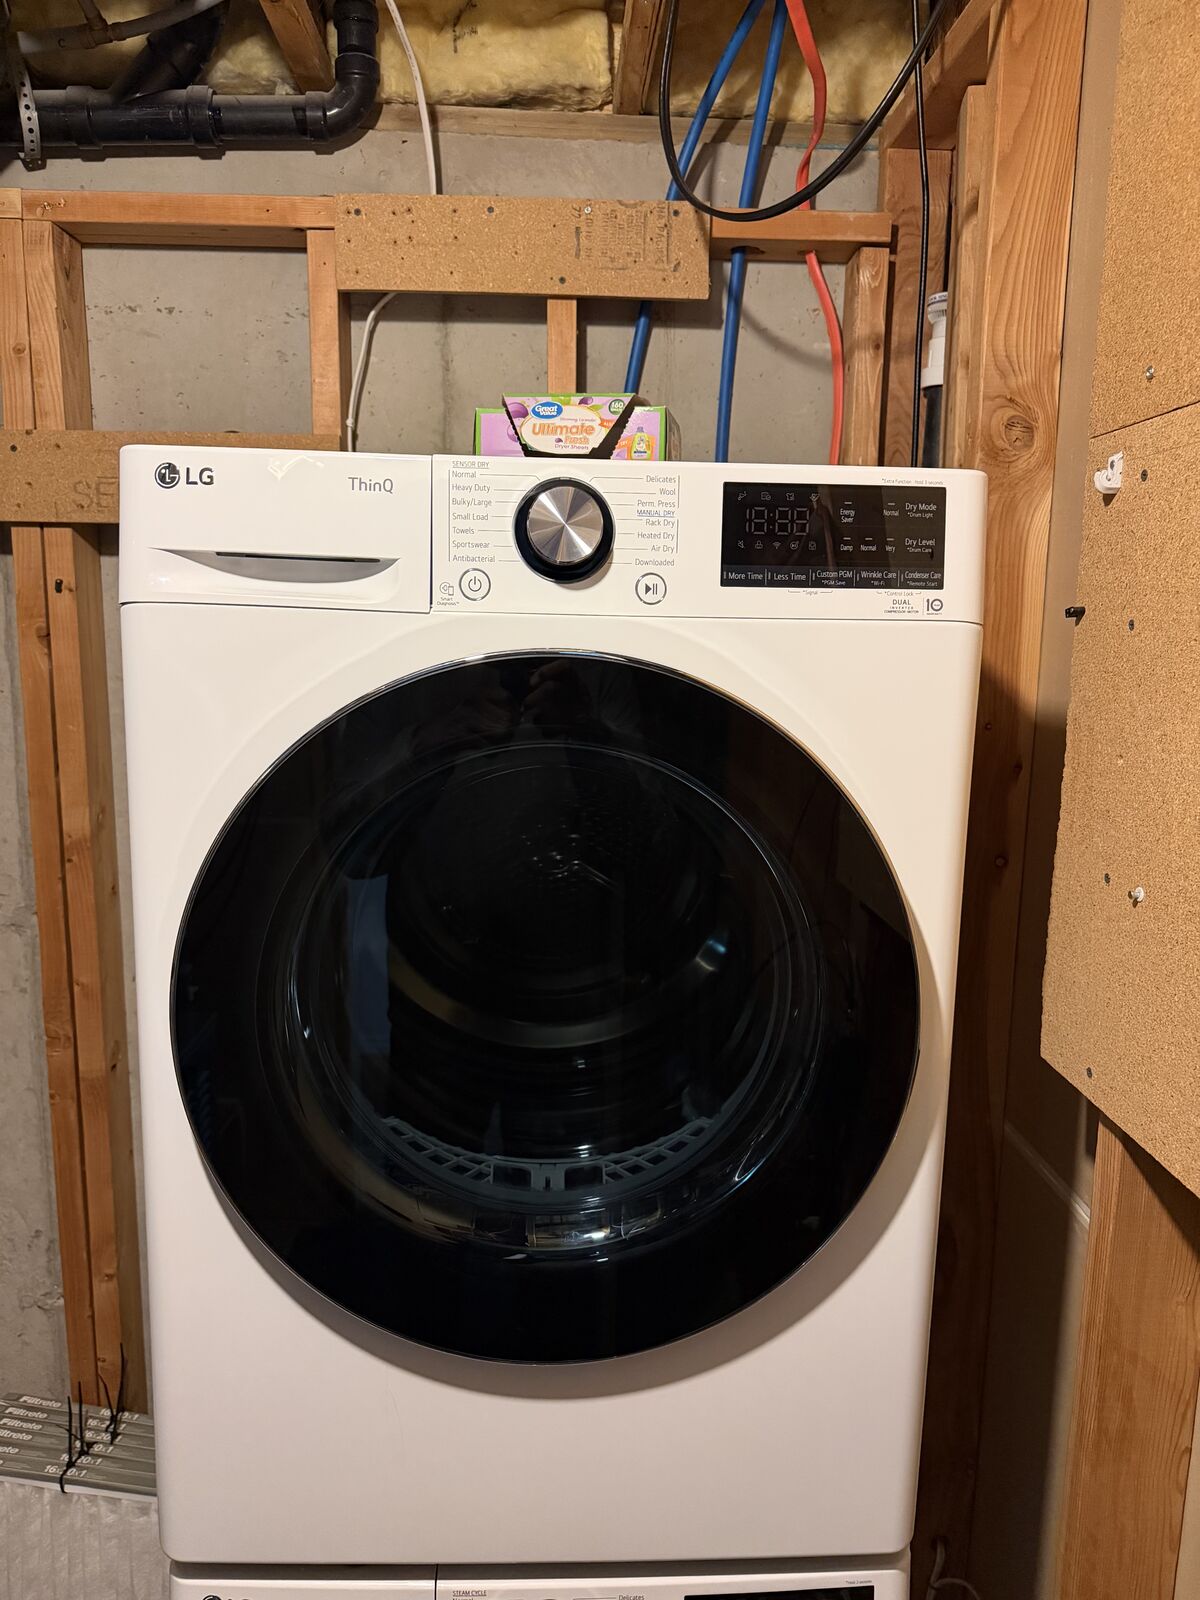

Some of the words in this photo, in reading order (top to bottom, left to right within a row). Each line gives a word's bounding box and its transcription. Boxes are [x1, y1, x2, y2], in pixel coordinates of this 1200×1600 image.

[534, 405, 558, 413] Great
[532, 423, 596, 436] Ultimate
[186, 467, 215, 485] LG
[452, 470, 477, 478] Normal
[646, 475, 676, 483] Delicates
[348, 477, 394, 494] ThinQ
[452, 484, 473, 493] Heavy
[474, 484, 491, 493] Duty
[659, 487, 676, 495] Wool
[452, 498, 493, 507] Bulky/Large
[637, 499, 657, 507] Perm.
[658, 499, 676, 508] Press
[905, 502, 917, 512] Dry
[918, 503, 937, 511] Mode
[452, 513, 471, 521] Small
[472, 513, 489, 521] Load
[840, 508, 856, 517] Energy
[663, 519, 676, 528] Dry
[452, 526, 475, 535] Towels
[637, 531, 661, 539] Heated
[663, 532, 675, 541] Dry
[452, 540, 490, 549] Sportswear
[905, 538, 917, 547] Dry
[918, 538, 936, 546] Level
[663, 545, 675, 554] Dry
[840, 544, 853, 552] Damp
[452, 554, 496, 563] Antibacterial
[634, 558, 675, 566] Downloaded
[728, 572, 746, 580] More
[747, 572, 764, 580] Time
[816, 570, 838, 578] Custom
[839, 570, 853, 578] PGM
[861, 571, 882, 579] Wrinkle
[883, 571, 897, 579] Care
[904, 571, 930, 579] Condenser
[892, 598, 911, 606] DUAL
